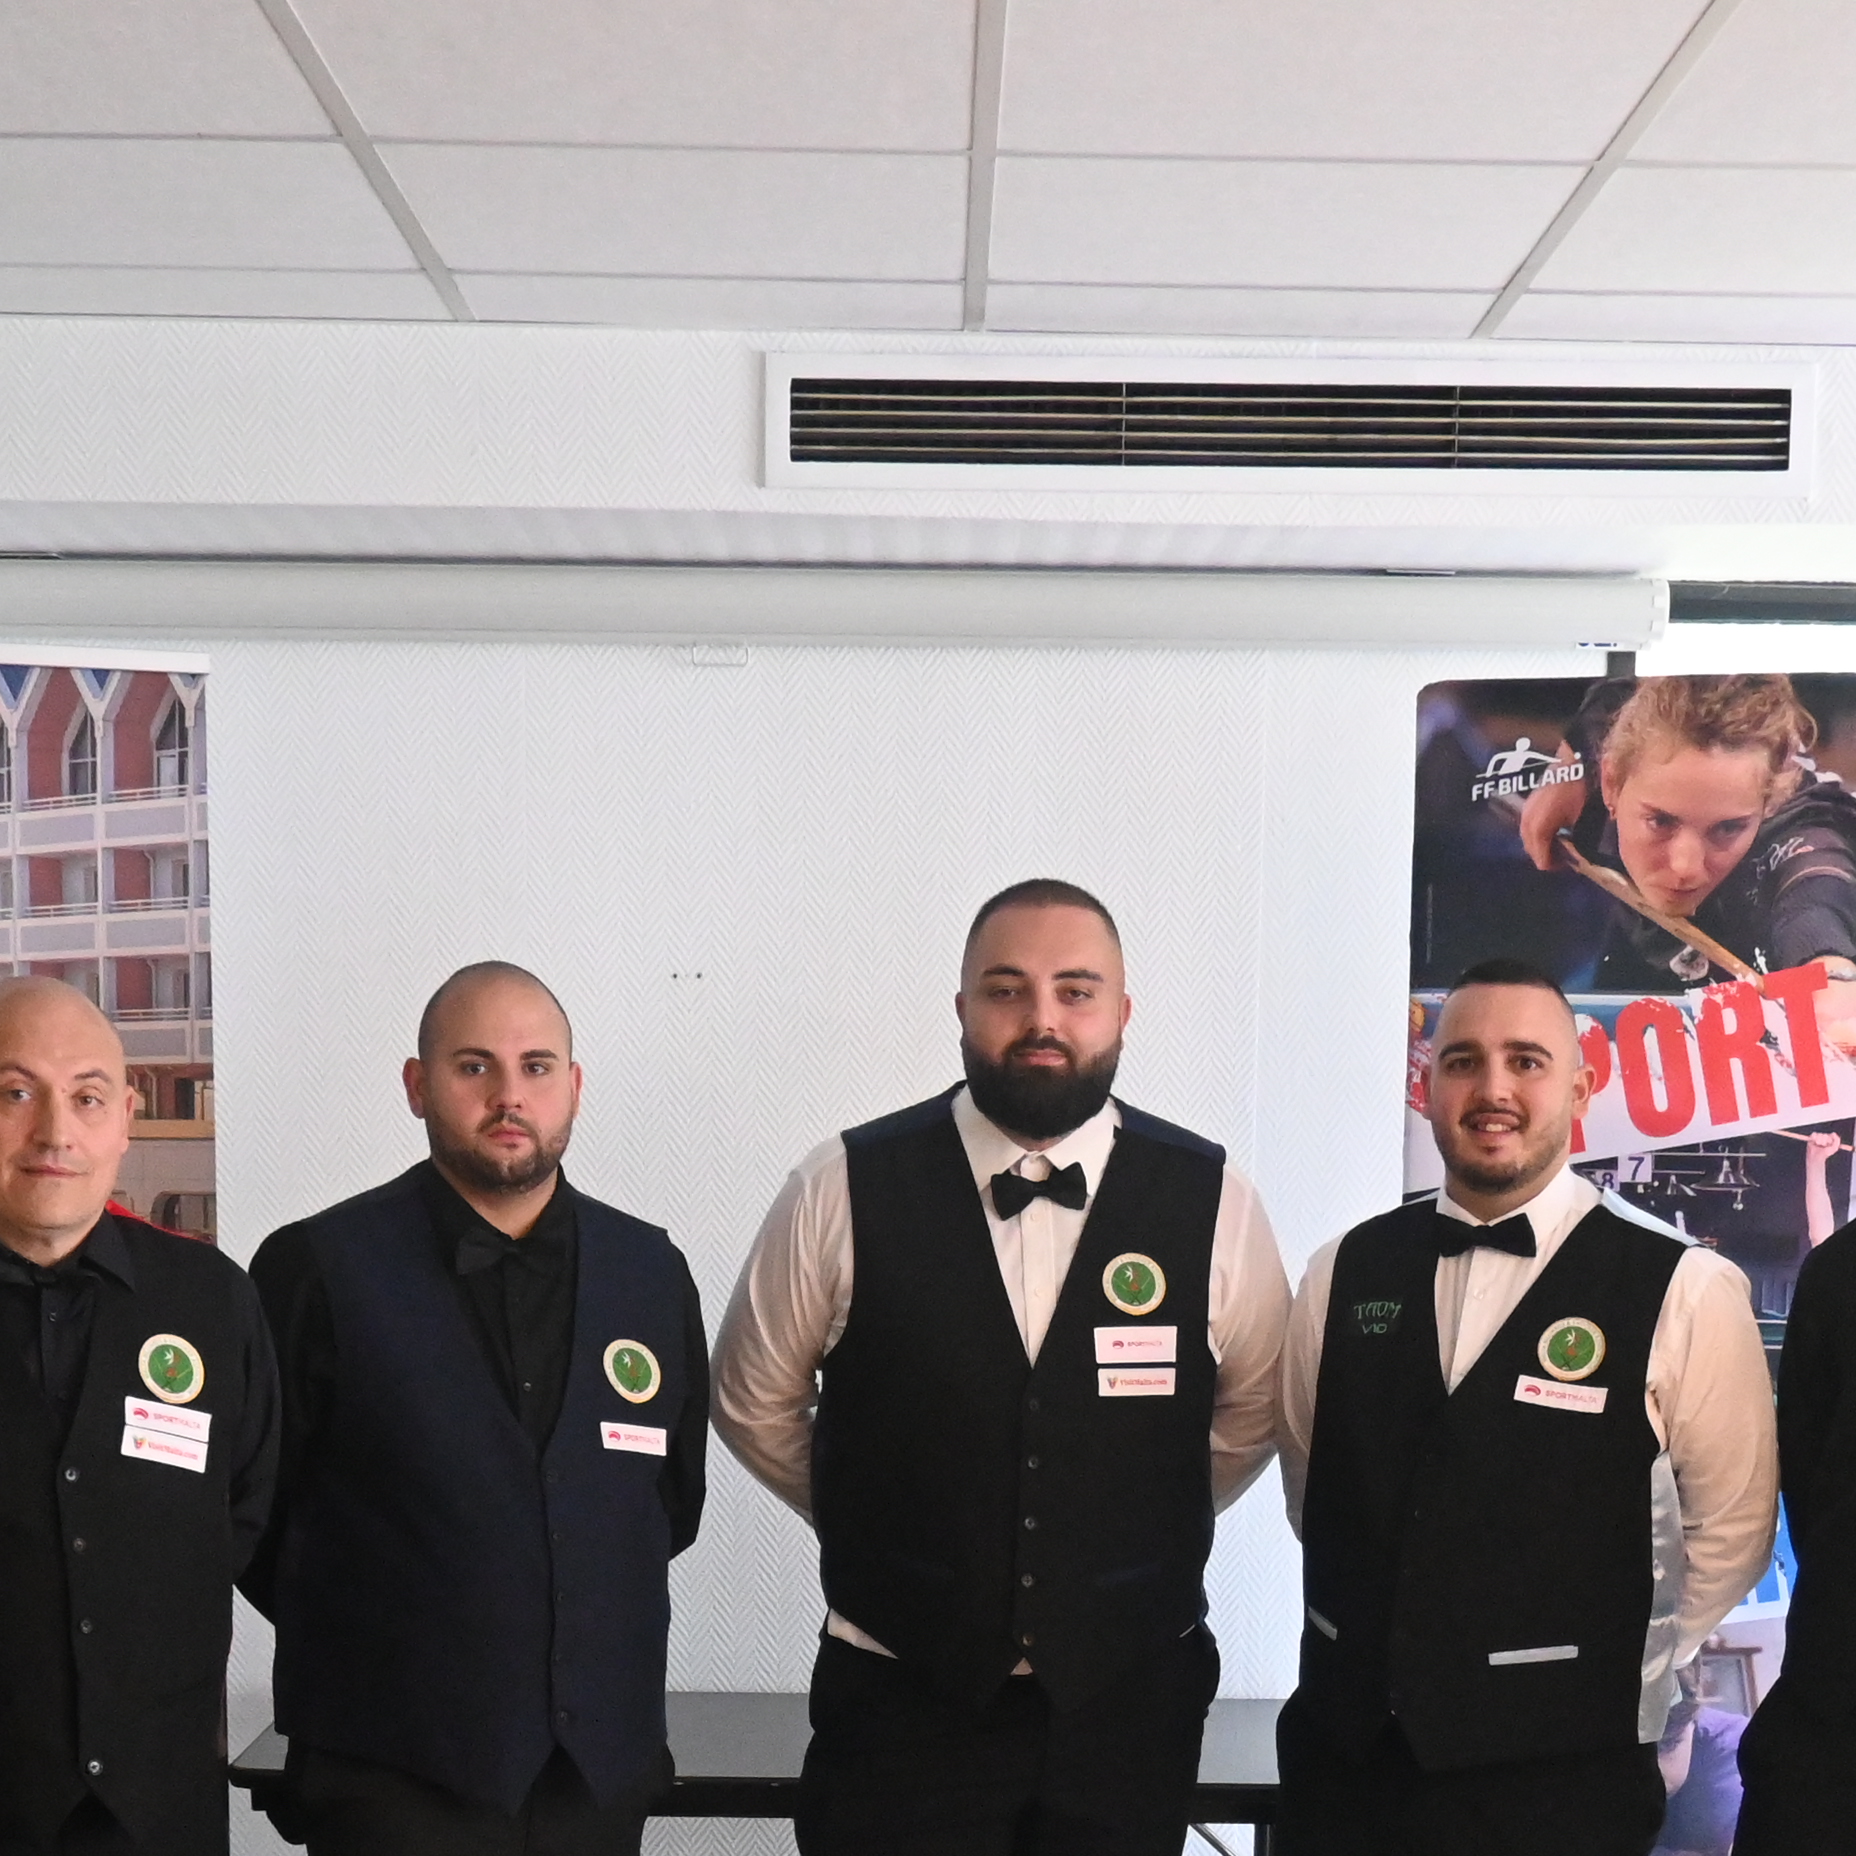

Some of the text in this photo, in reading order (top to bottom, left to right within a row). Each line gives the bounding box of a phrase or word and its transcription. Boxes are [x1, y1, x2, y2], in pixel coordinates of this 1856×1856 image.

[1471, 763, 1584, 802] FF BILLARD
[1627, 1156, 1644, 1181] 7
[1601, 1172, 1614, 1190] 8
[1545, 1389, 1598, 1404] SPORTMALTA
